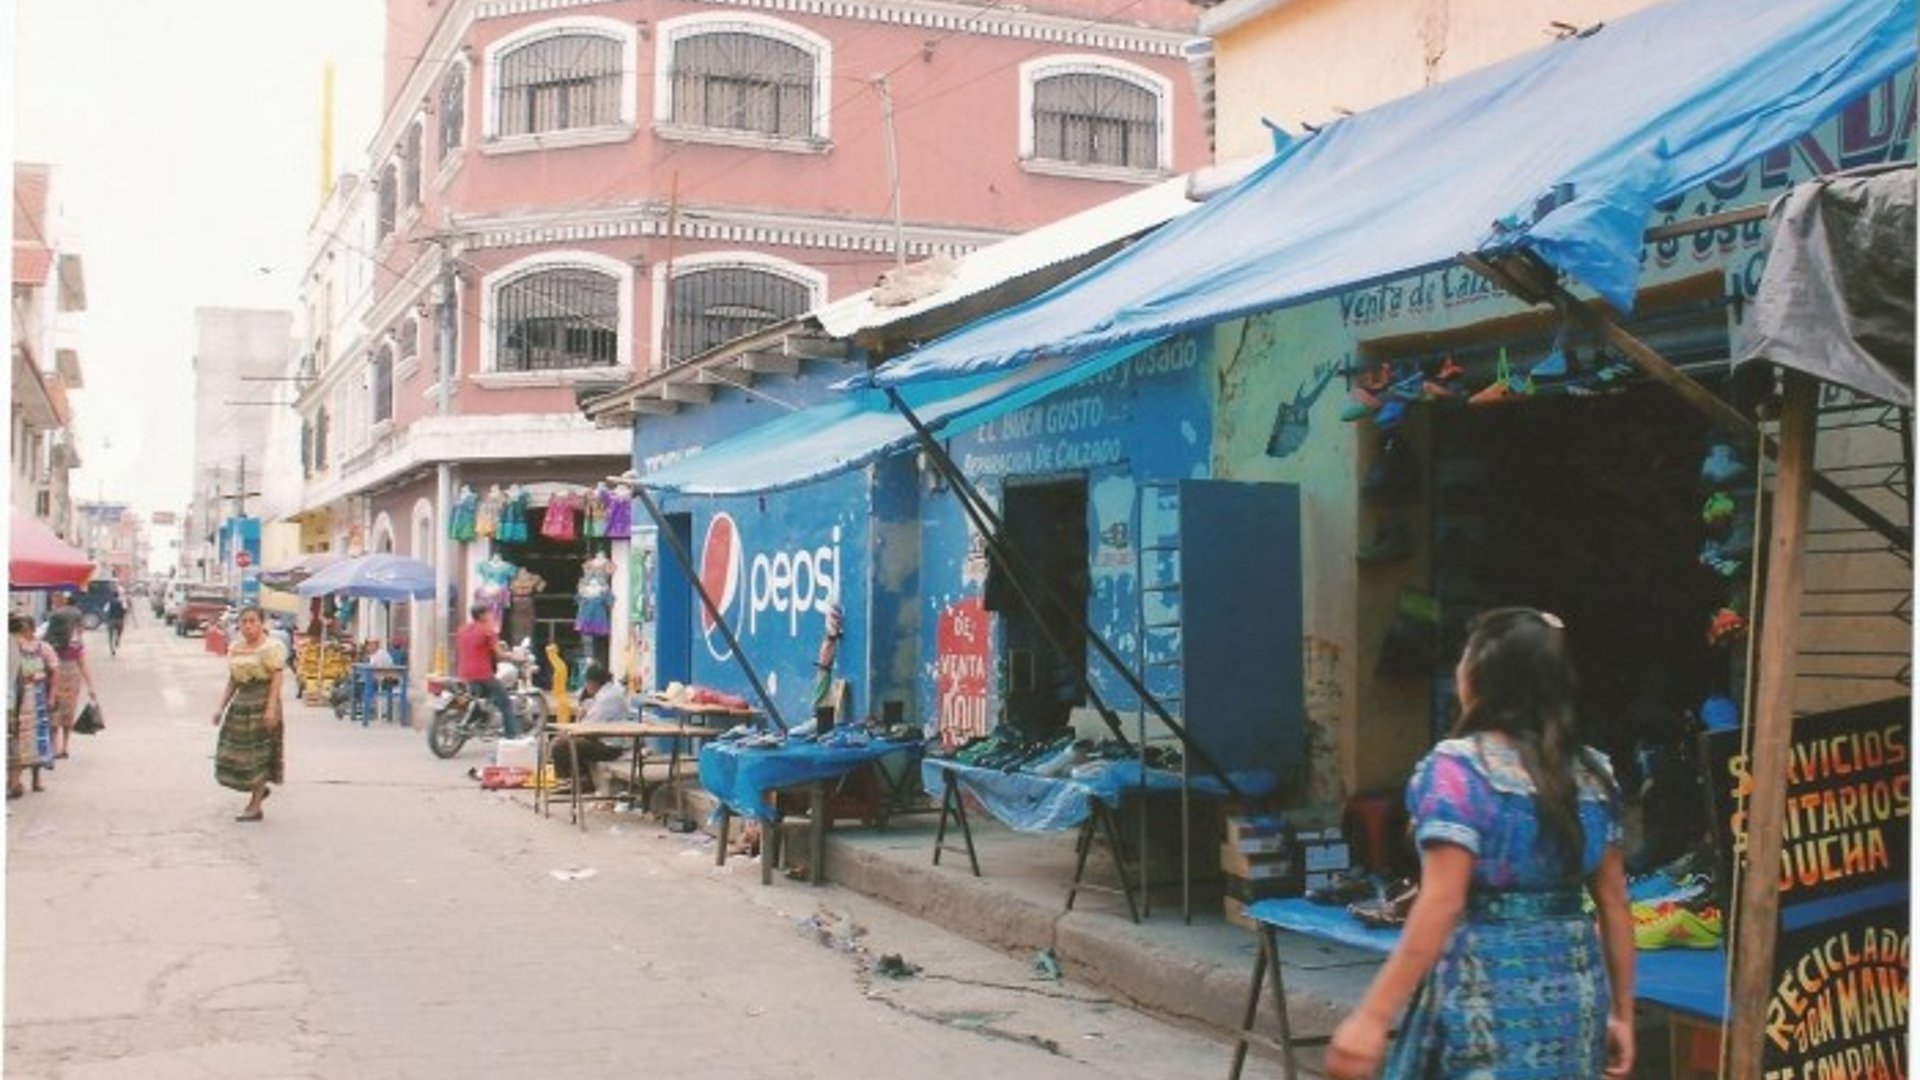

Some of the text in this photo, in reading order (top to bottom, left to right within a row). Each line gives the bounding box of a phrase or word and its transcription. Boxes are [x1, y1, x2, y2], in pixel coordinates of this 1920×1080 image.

[1340, 285, 1402, 324] Venta
[1409, 270, 1435, 308] de
[1047, 396, 1103, 432] GUSTO
[751, 525, 840, 637] pepsi
[943, 653, 985, 679] VENTA
